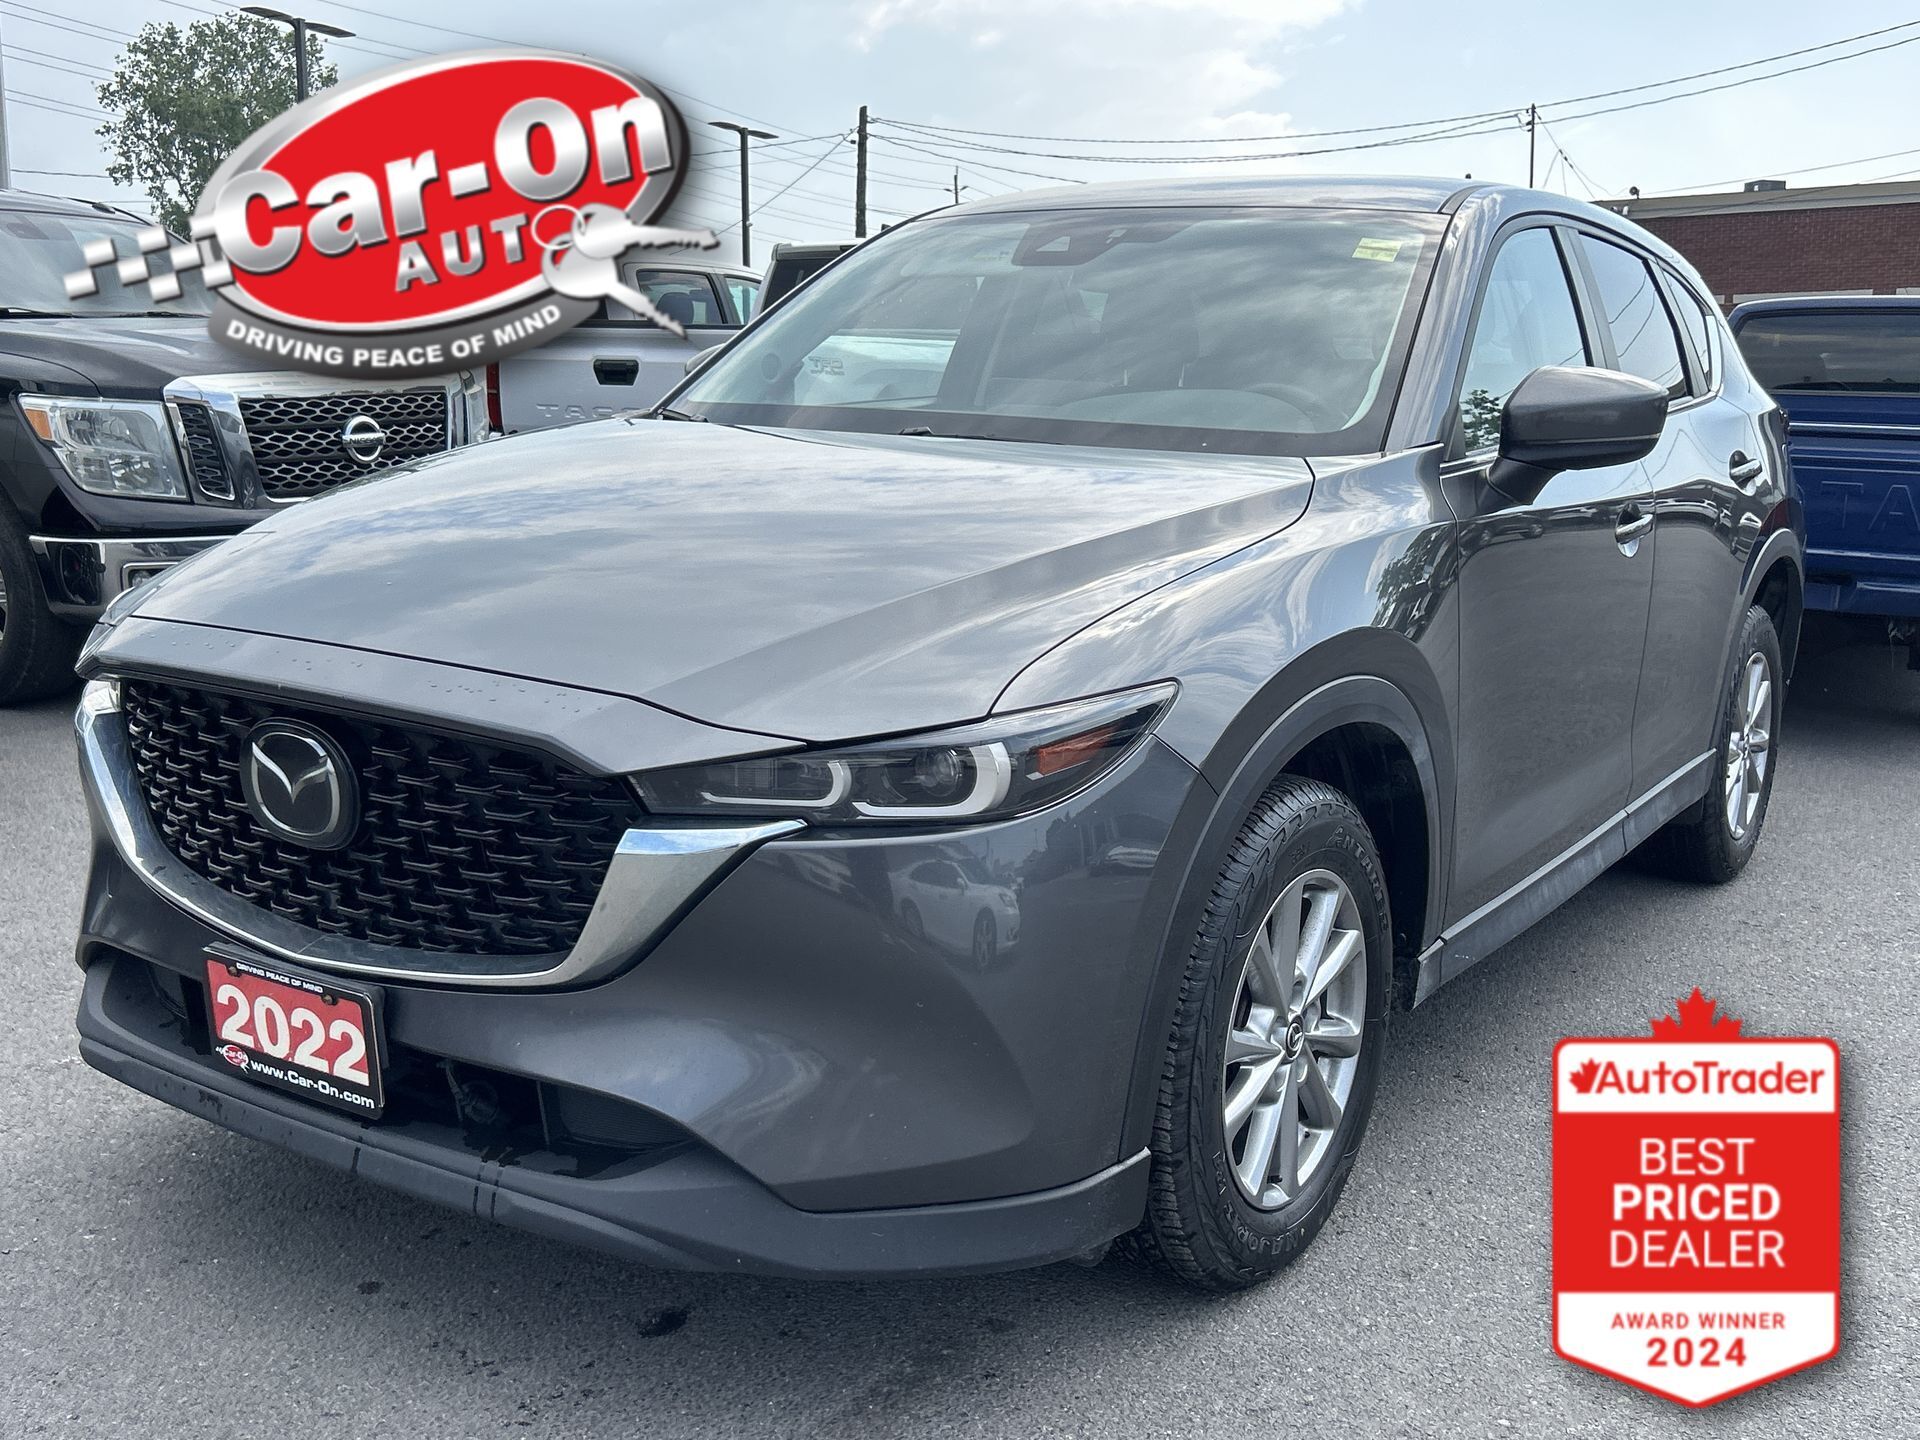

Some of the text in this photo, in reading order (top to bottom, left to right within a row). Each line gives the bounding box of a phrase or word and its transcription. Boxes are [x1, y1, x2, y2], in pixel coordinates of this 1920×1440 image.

[536, 403, 640, 419] TAC
[236, 961, 323, 994] DRIVING PEACE OF MIND
[216, 983, 370, 1087] 2022
[250, 1059, 376, 1110] www.Car-On.com
